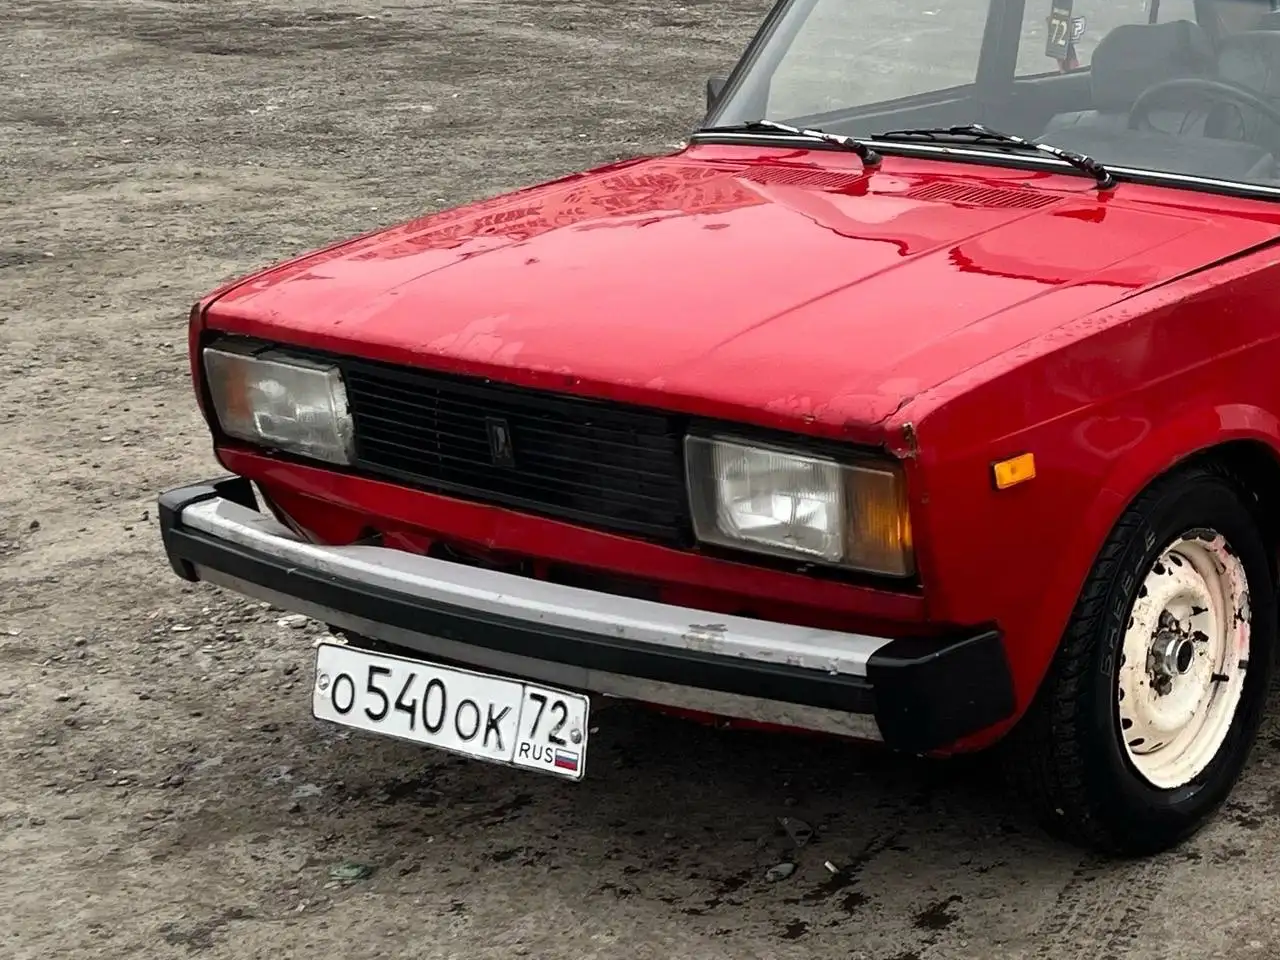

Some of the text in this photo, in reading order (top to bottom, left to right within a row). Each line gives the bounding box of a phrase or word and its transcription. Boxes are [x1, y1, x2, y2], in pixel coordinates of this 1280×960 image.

[1051, 18, 1067, 46] 72
[529, 692, 568, 746] 72
[518, 742, 554, 764] RUS
